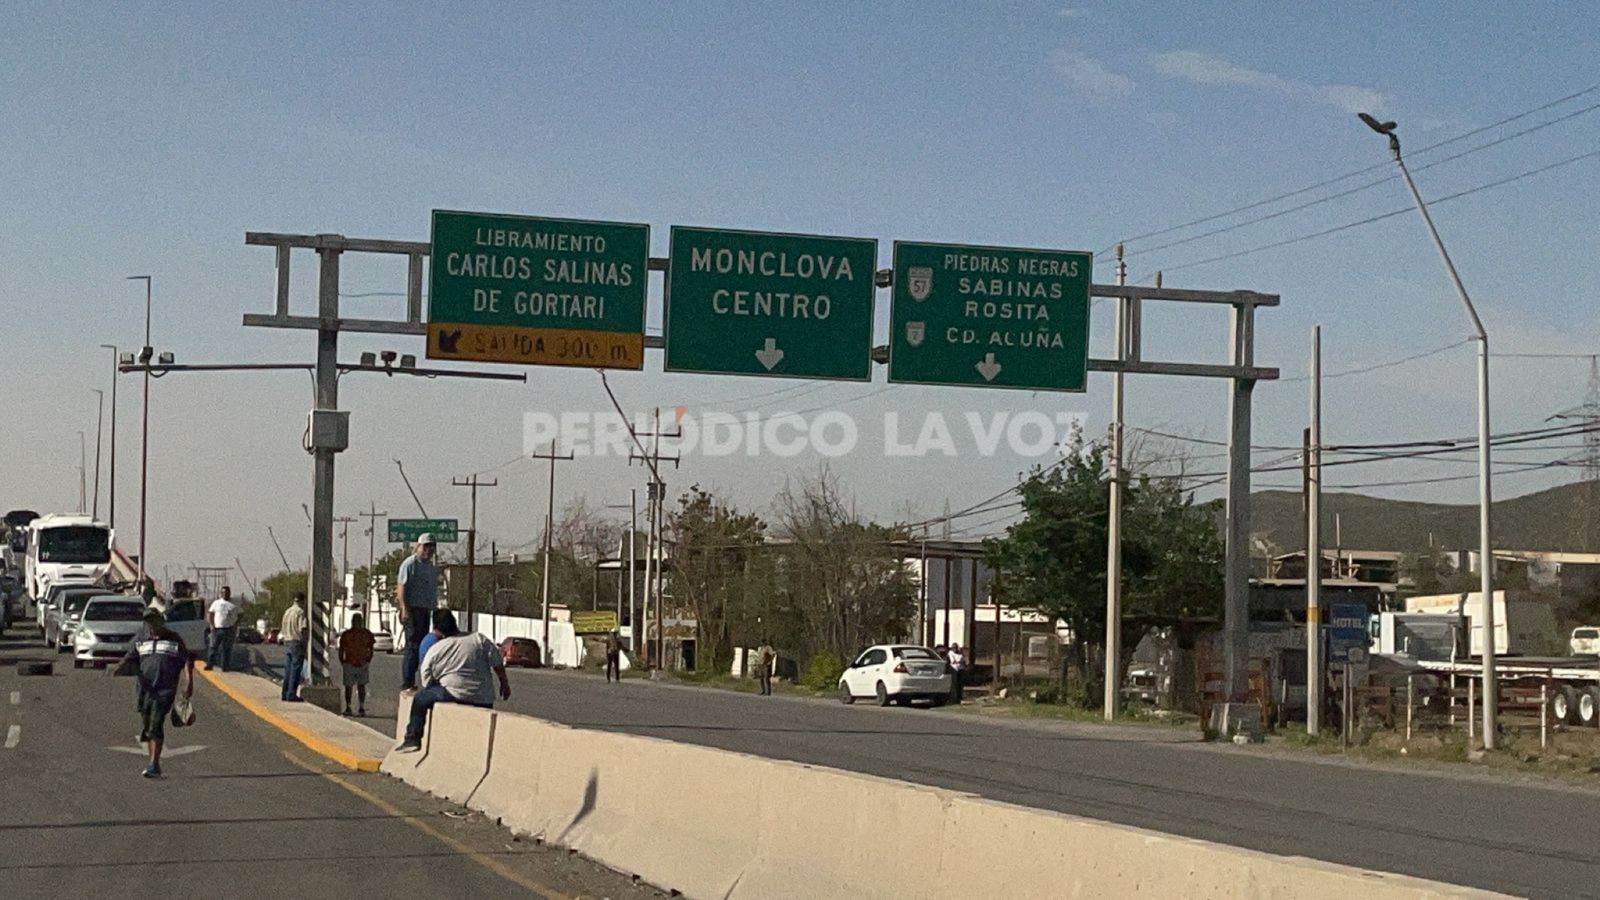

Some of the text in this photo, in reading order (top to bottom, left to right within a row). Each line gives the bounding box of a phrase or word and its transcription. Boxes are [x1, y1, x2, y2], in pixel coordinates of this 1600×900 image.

[475, 227, 607, 253] LIBRAMIENTO
[447, 252, 632, 287] CARLOS SALINAS
[691, 247, 854, 281] MONCLOVA
[944, 253, 1010, 275] PIEDRAS
[1018, 258, 1079, 278] NEGRAS
[913, 280, 927, 293] 57
[958, 276, 1063, 300] SABINAS
[473, 288, 605, 319] DE GORTARI
[712, 288, 831, 320] CENTRO
[964, 300, 1050, 321] ROSITA
[989, 327, 1064, 350] ACUÑA
